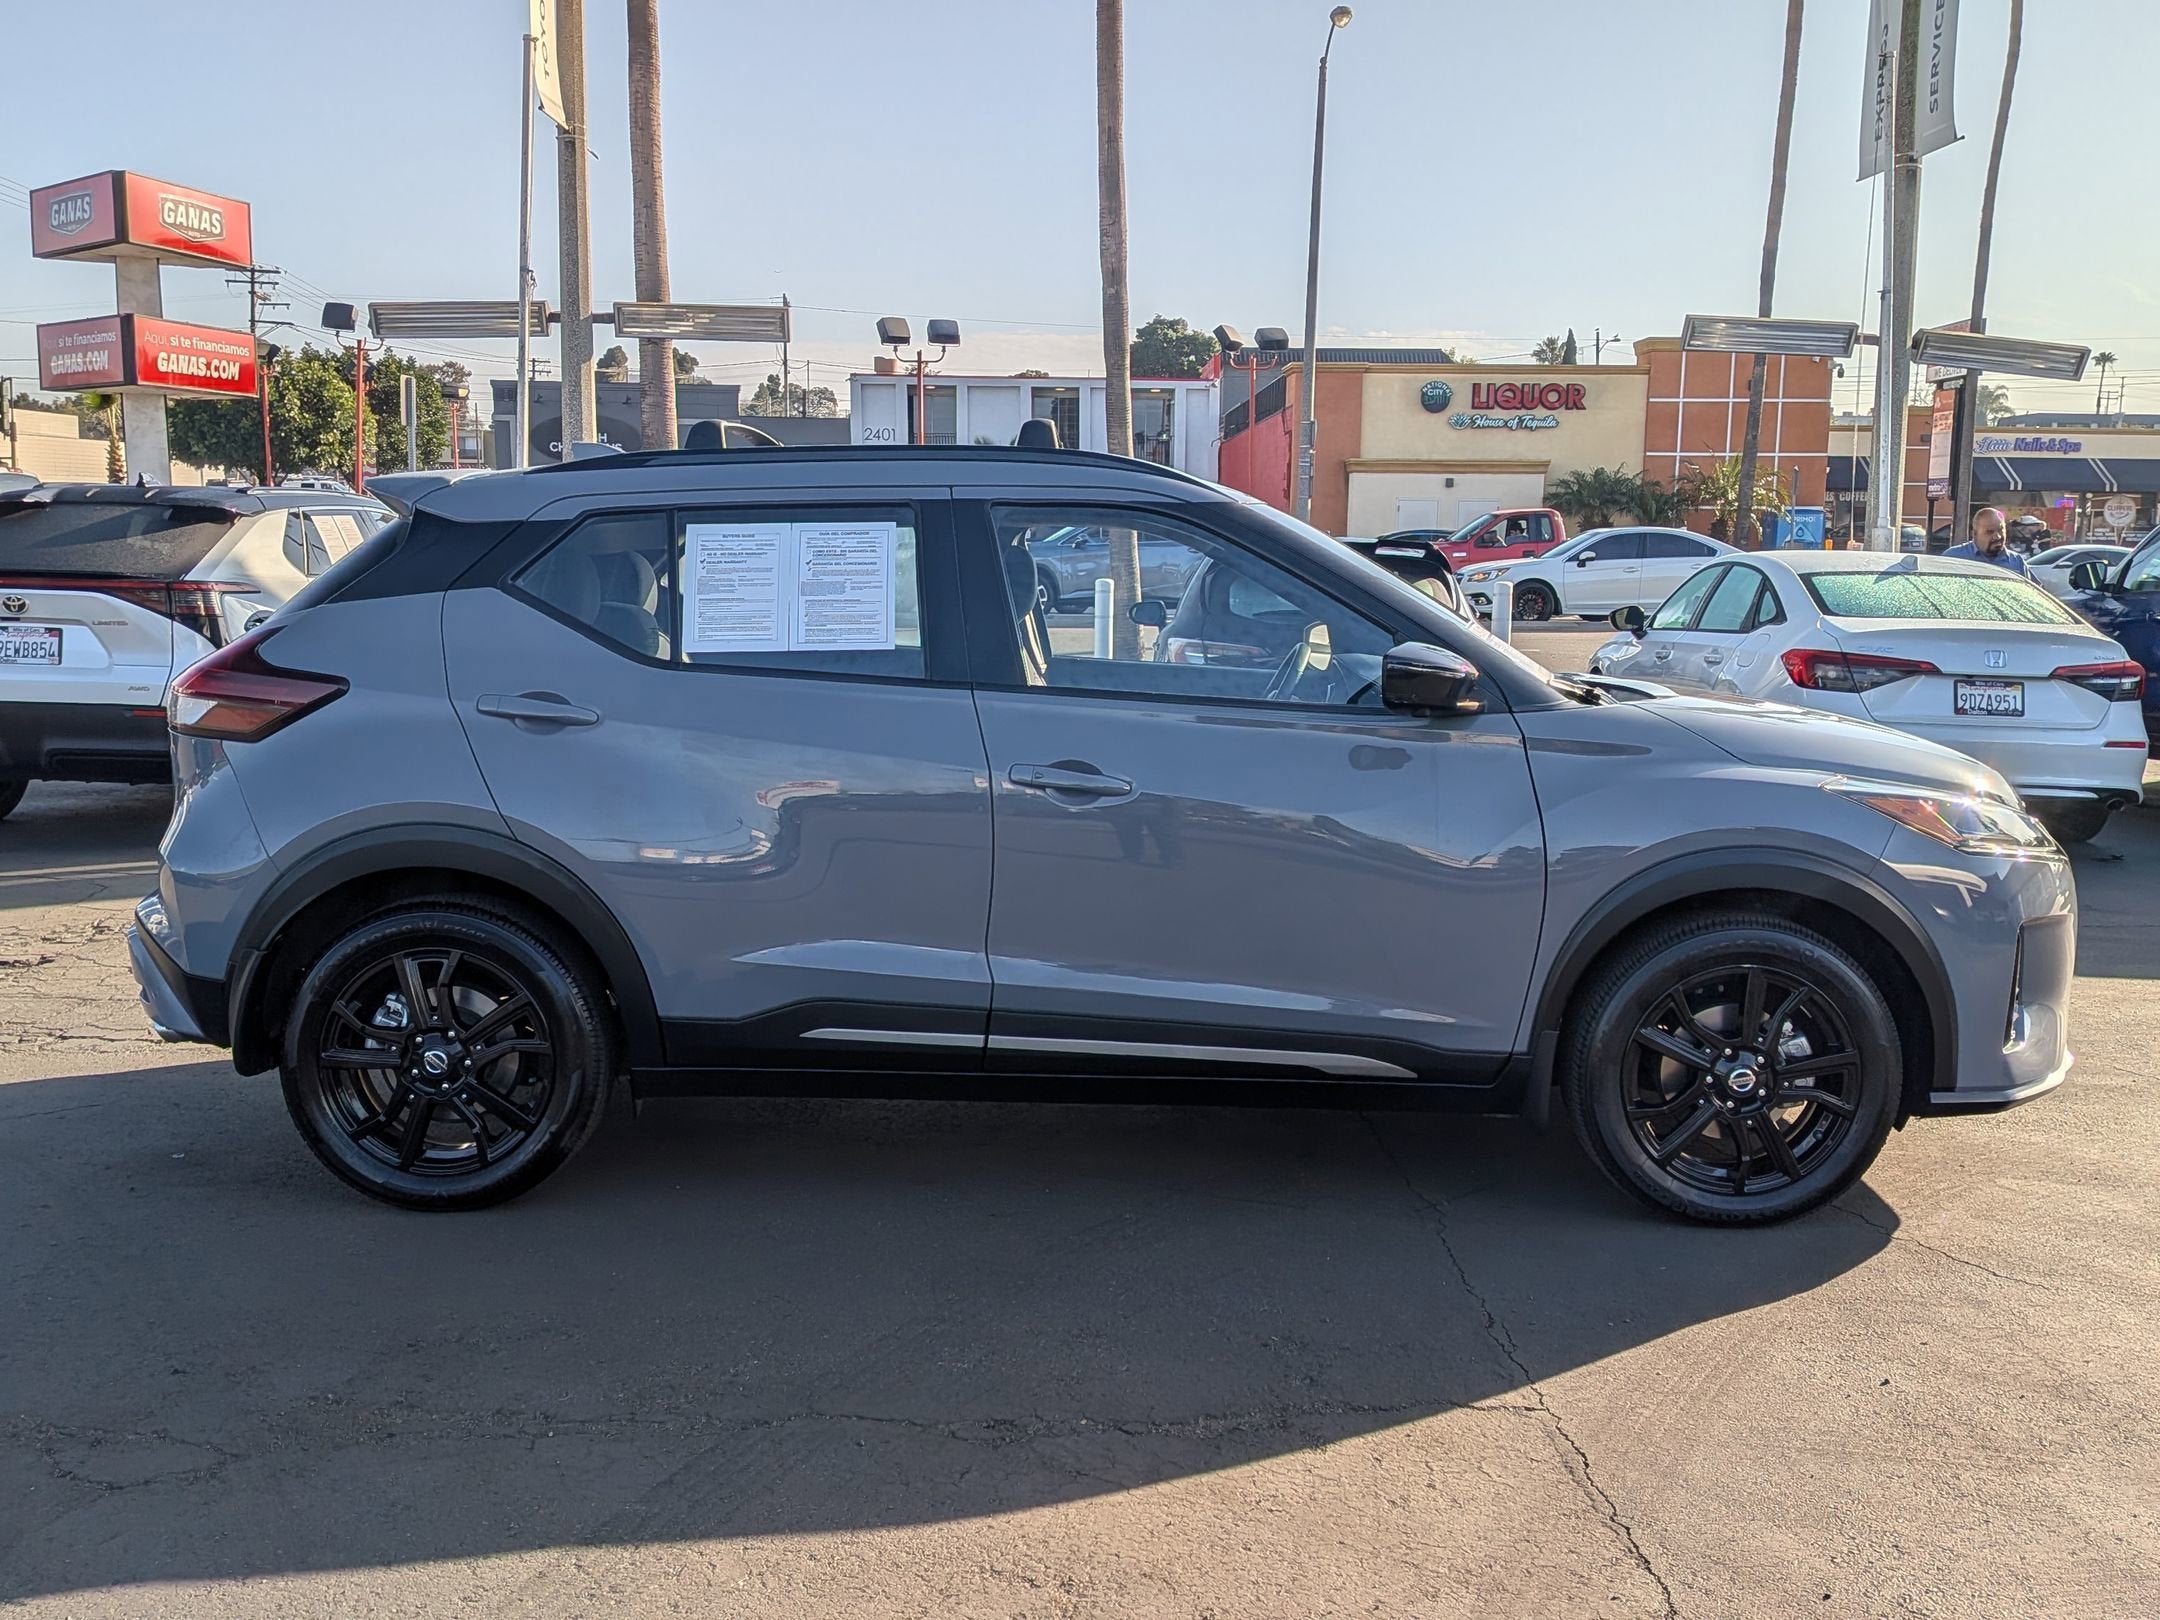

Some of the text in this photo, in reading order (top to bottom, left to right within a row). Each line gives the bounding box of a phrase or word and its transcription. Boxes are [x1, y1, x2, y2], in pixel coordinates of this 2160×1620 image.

[1929, 0, 1945, 114] SERVICE
[51, 196, 91, 227] GANAS
[163, 201, 222, 234] GANAS
[65, 333, 73, 347] te
[73, 331, 117, 346] financiamos
[181, 335, 192, 349] te
[193, 336, 250, 357] financiamos
[51, 350, 109, 376] GANAS.COM
[157, 351, 240, 381] GANAS.COM
[1471, 382, 1587, 411] LIQUOR
[863, 426, 896, 442] 2401
[1471, 414, 1559, 431] House of Tequila
[2013, 437, 2047, 452] Nails
[2046, 438, 2058, 452] &
[2058, 438, 2083, 455] Spa
[1960, 693, 2017, 711] 9DZA951
